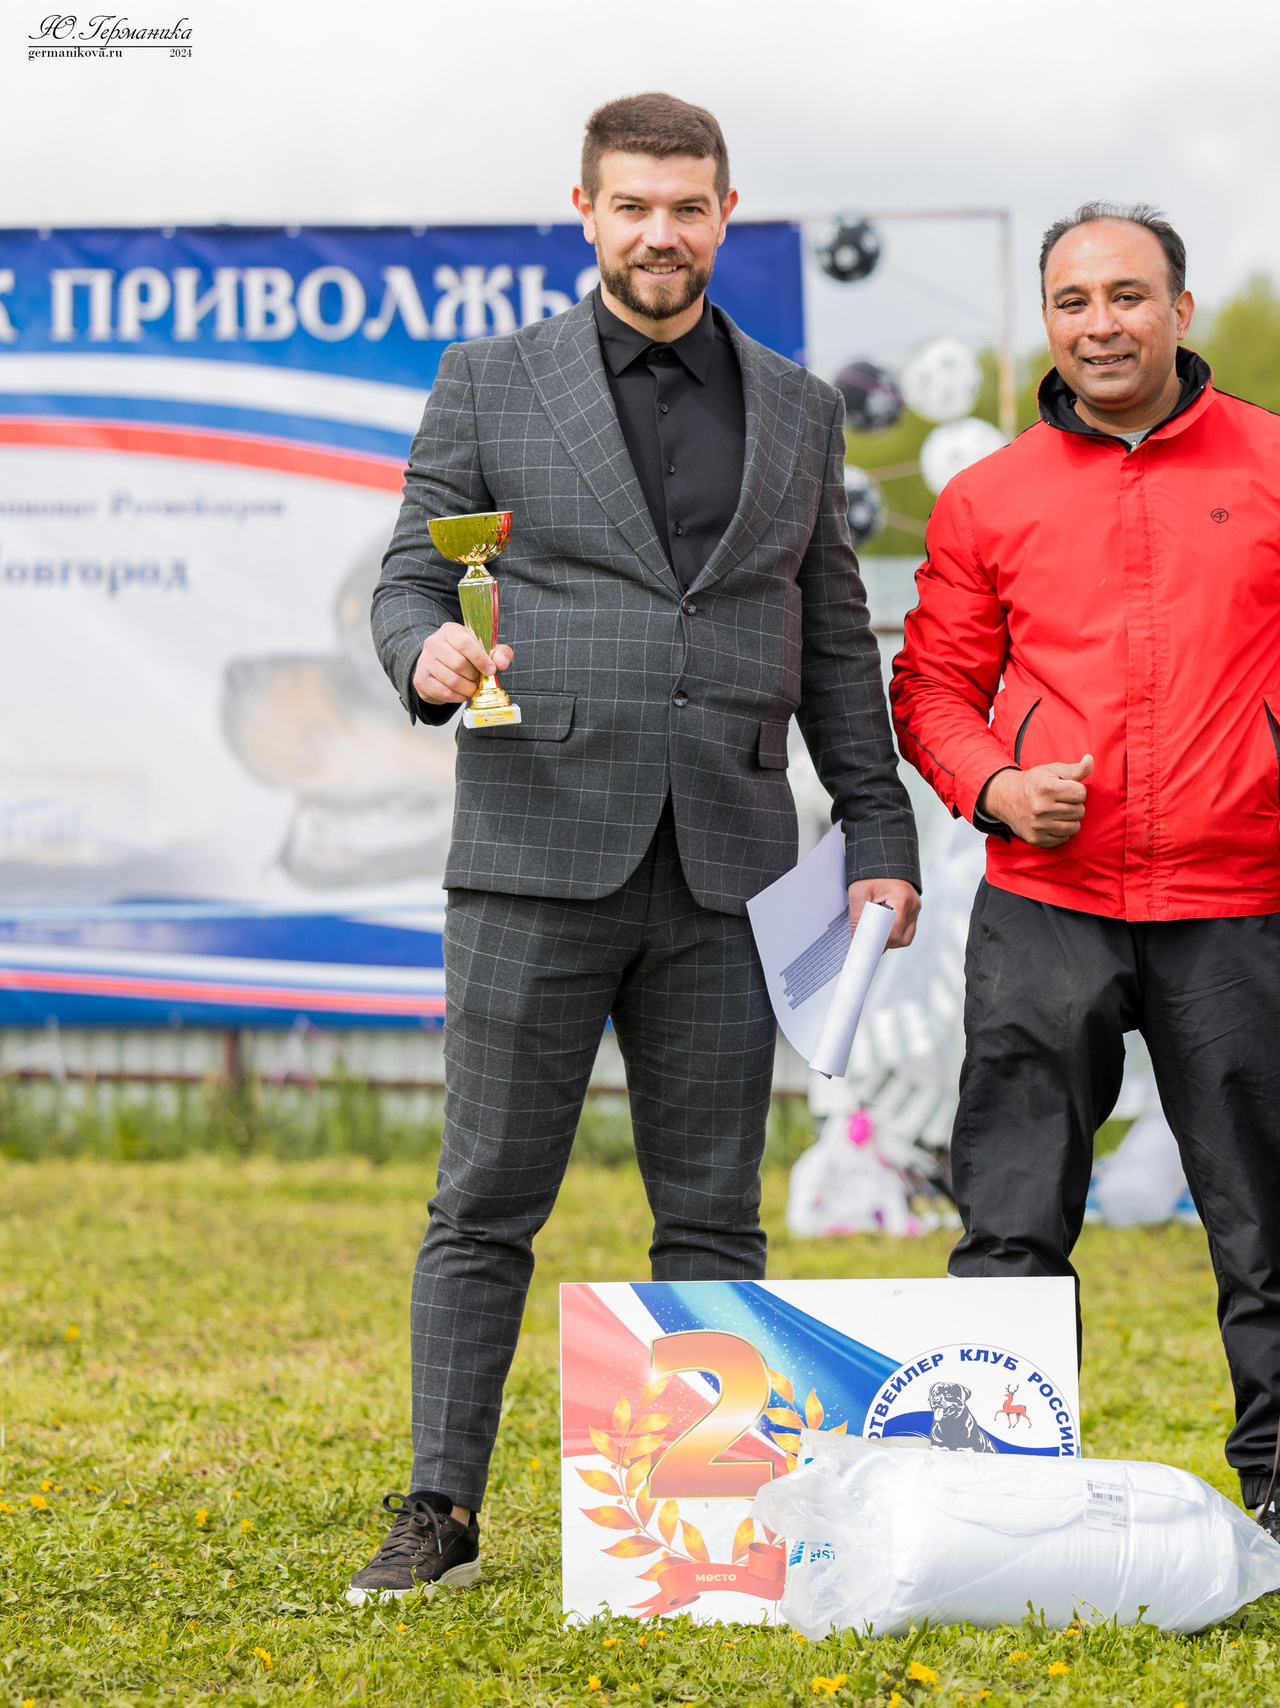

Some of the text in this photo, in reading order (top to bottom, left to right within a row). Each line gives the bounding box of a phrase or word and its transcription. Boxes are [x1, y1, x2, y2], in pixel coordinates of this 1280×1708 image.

[50, 266, 600, 343] ПРИВОЛЖЬ
[0, 545, 190, 599] овгород
[647, 1329, 775, 1500] 2
[959, 1348, 1020, 1371] КЛУБ
[1027, 1371, 1075, 1457] РОССИИ
[695, 1573, 737, 1582] место
